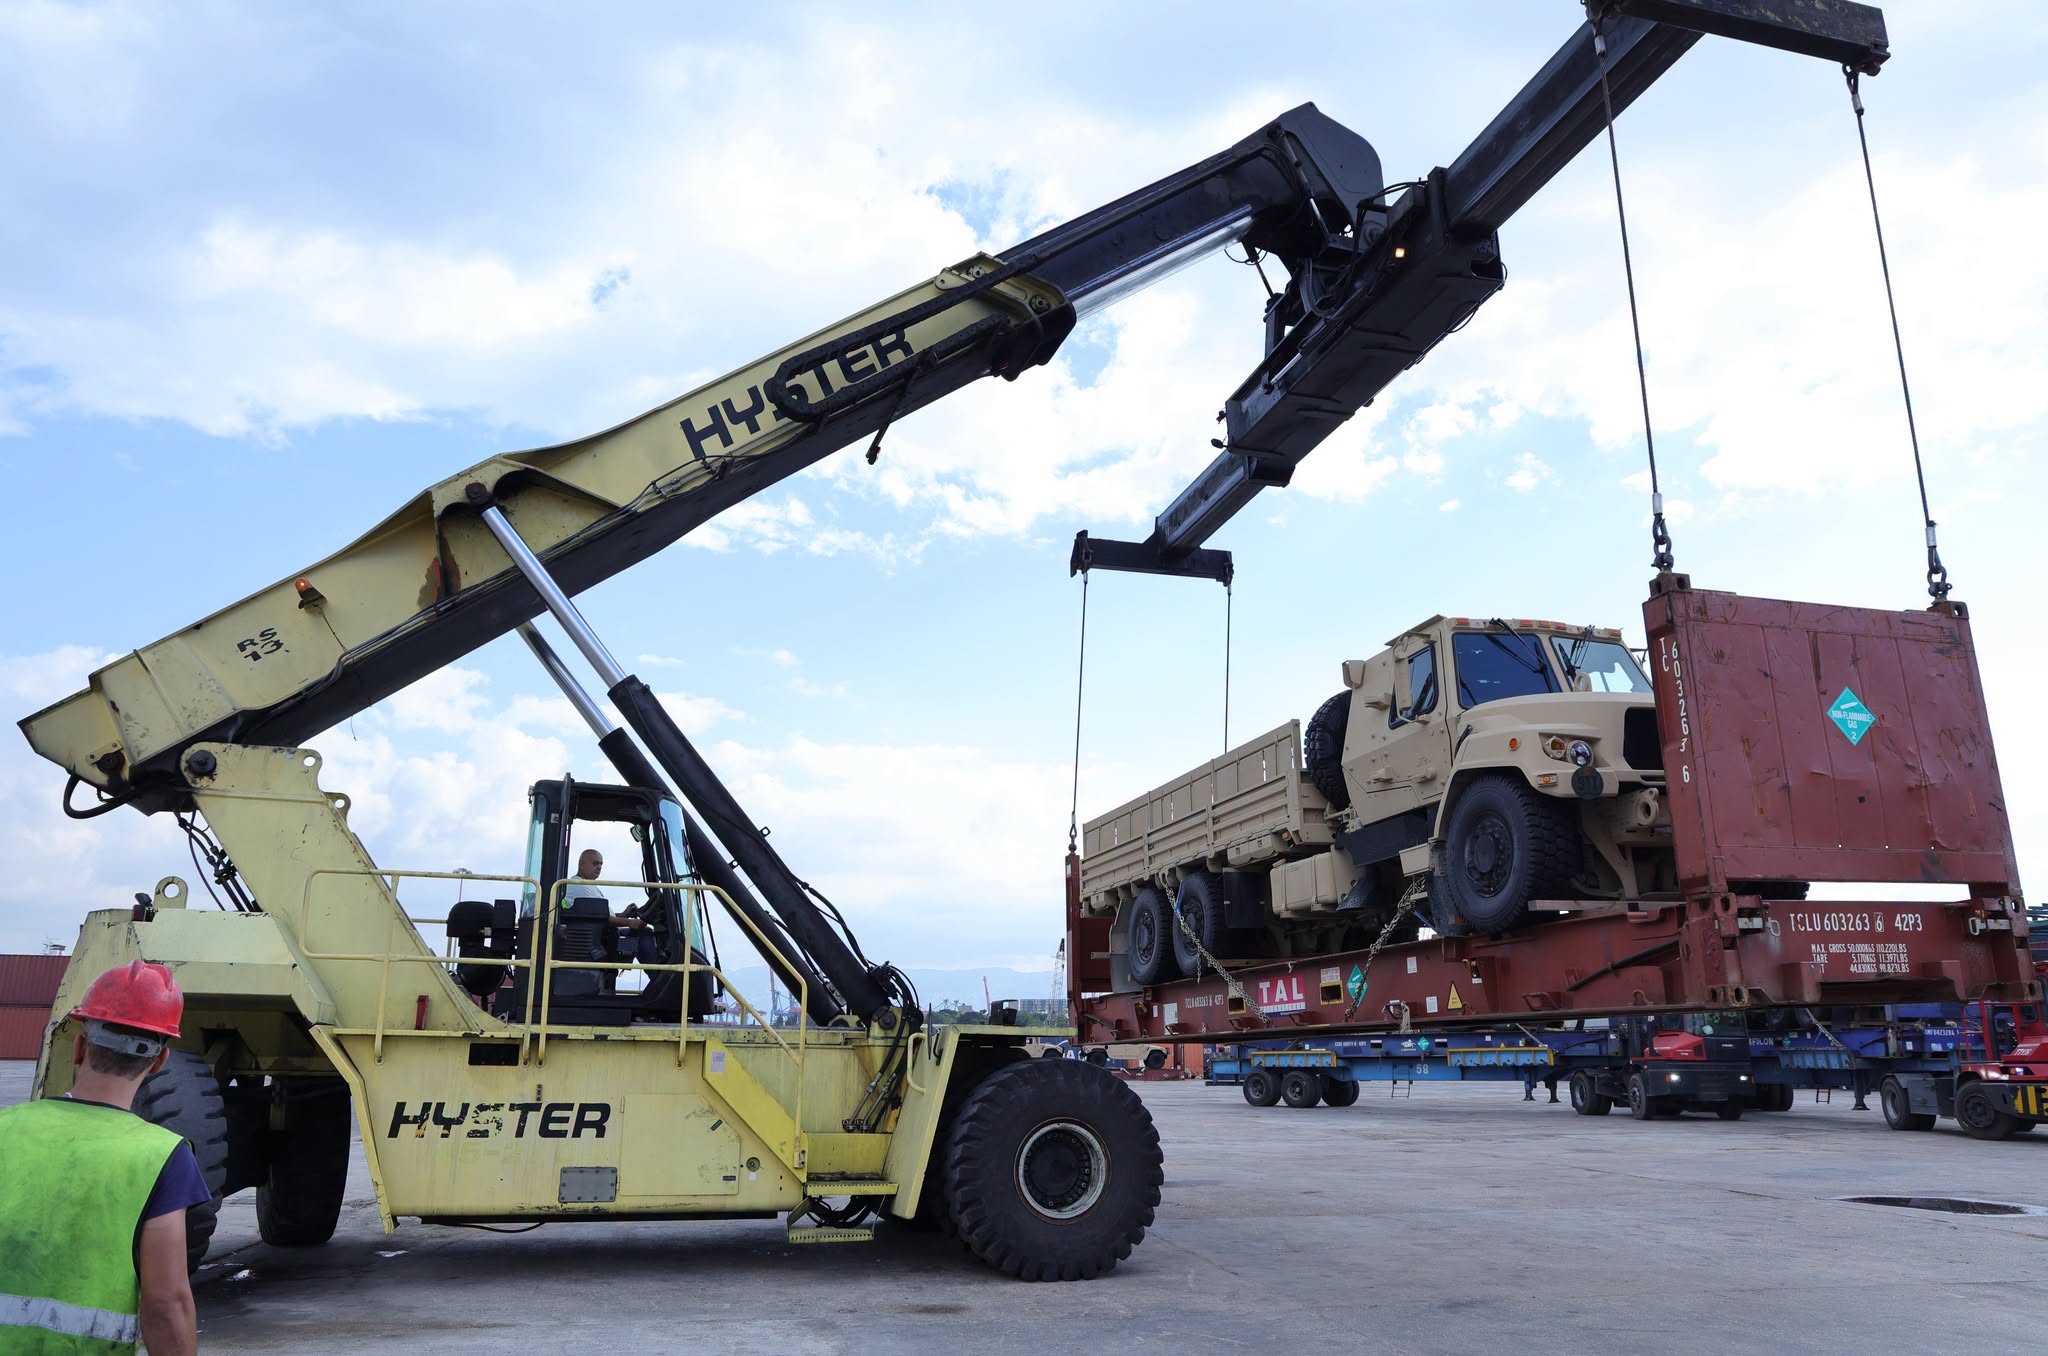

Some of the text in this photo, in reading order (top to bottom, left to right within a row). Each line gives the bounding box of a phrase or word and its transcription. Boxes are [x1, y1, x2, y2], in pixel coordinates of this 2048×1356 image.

[237, 627, 277, 652] RS
[1851, 731, 1857, 740] 2
[1894, 913, 1923, 931] 42P3
[1828, 944, 1847, 953] GROSS
[1812, 953, 1828, 963] TARE
[1259, 977, 1304, 1004] TAL
[1416, 1064, 1429, 1075] 58
[387, 1101, 611, 1139] HYSTER
